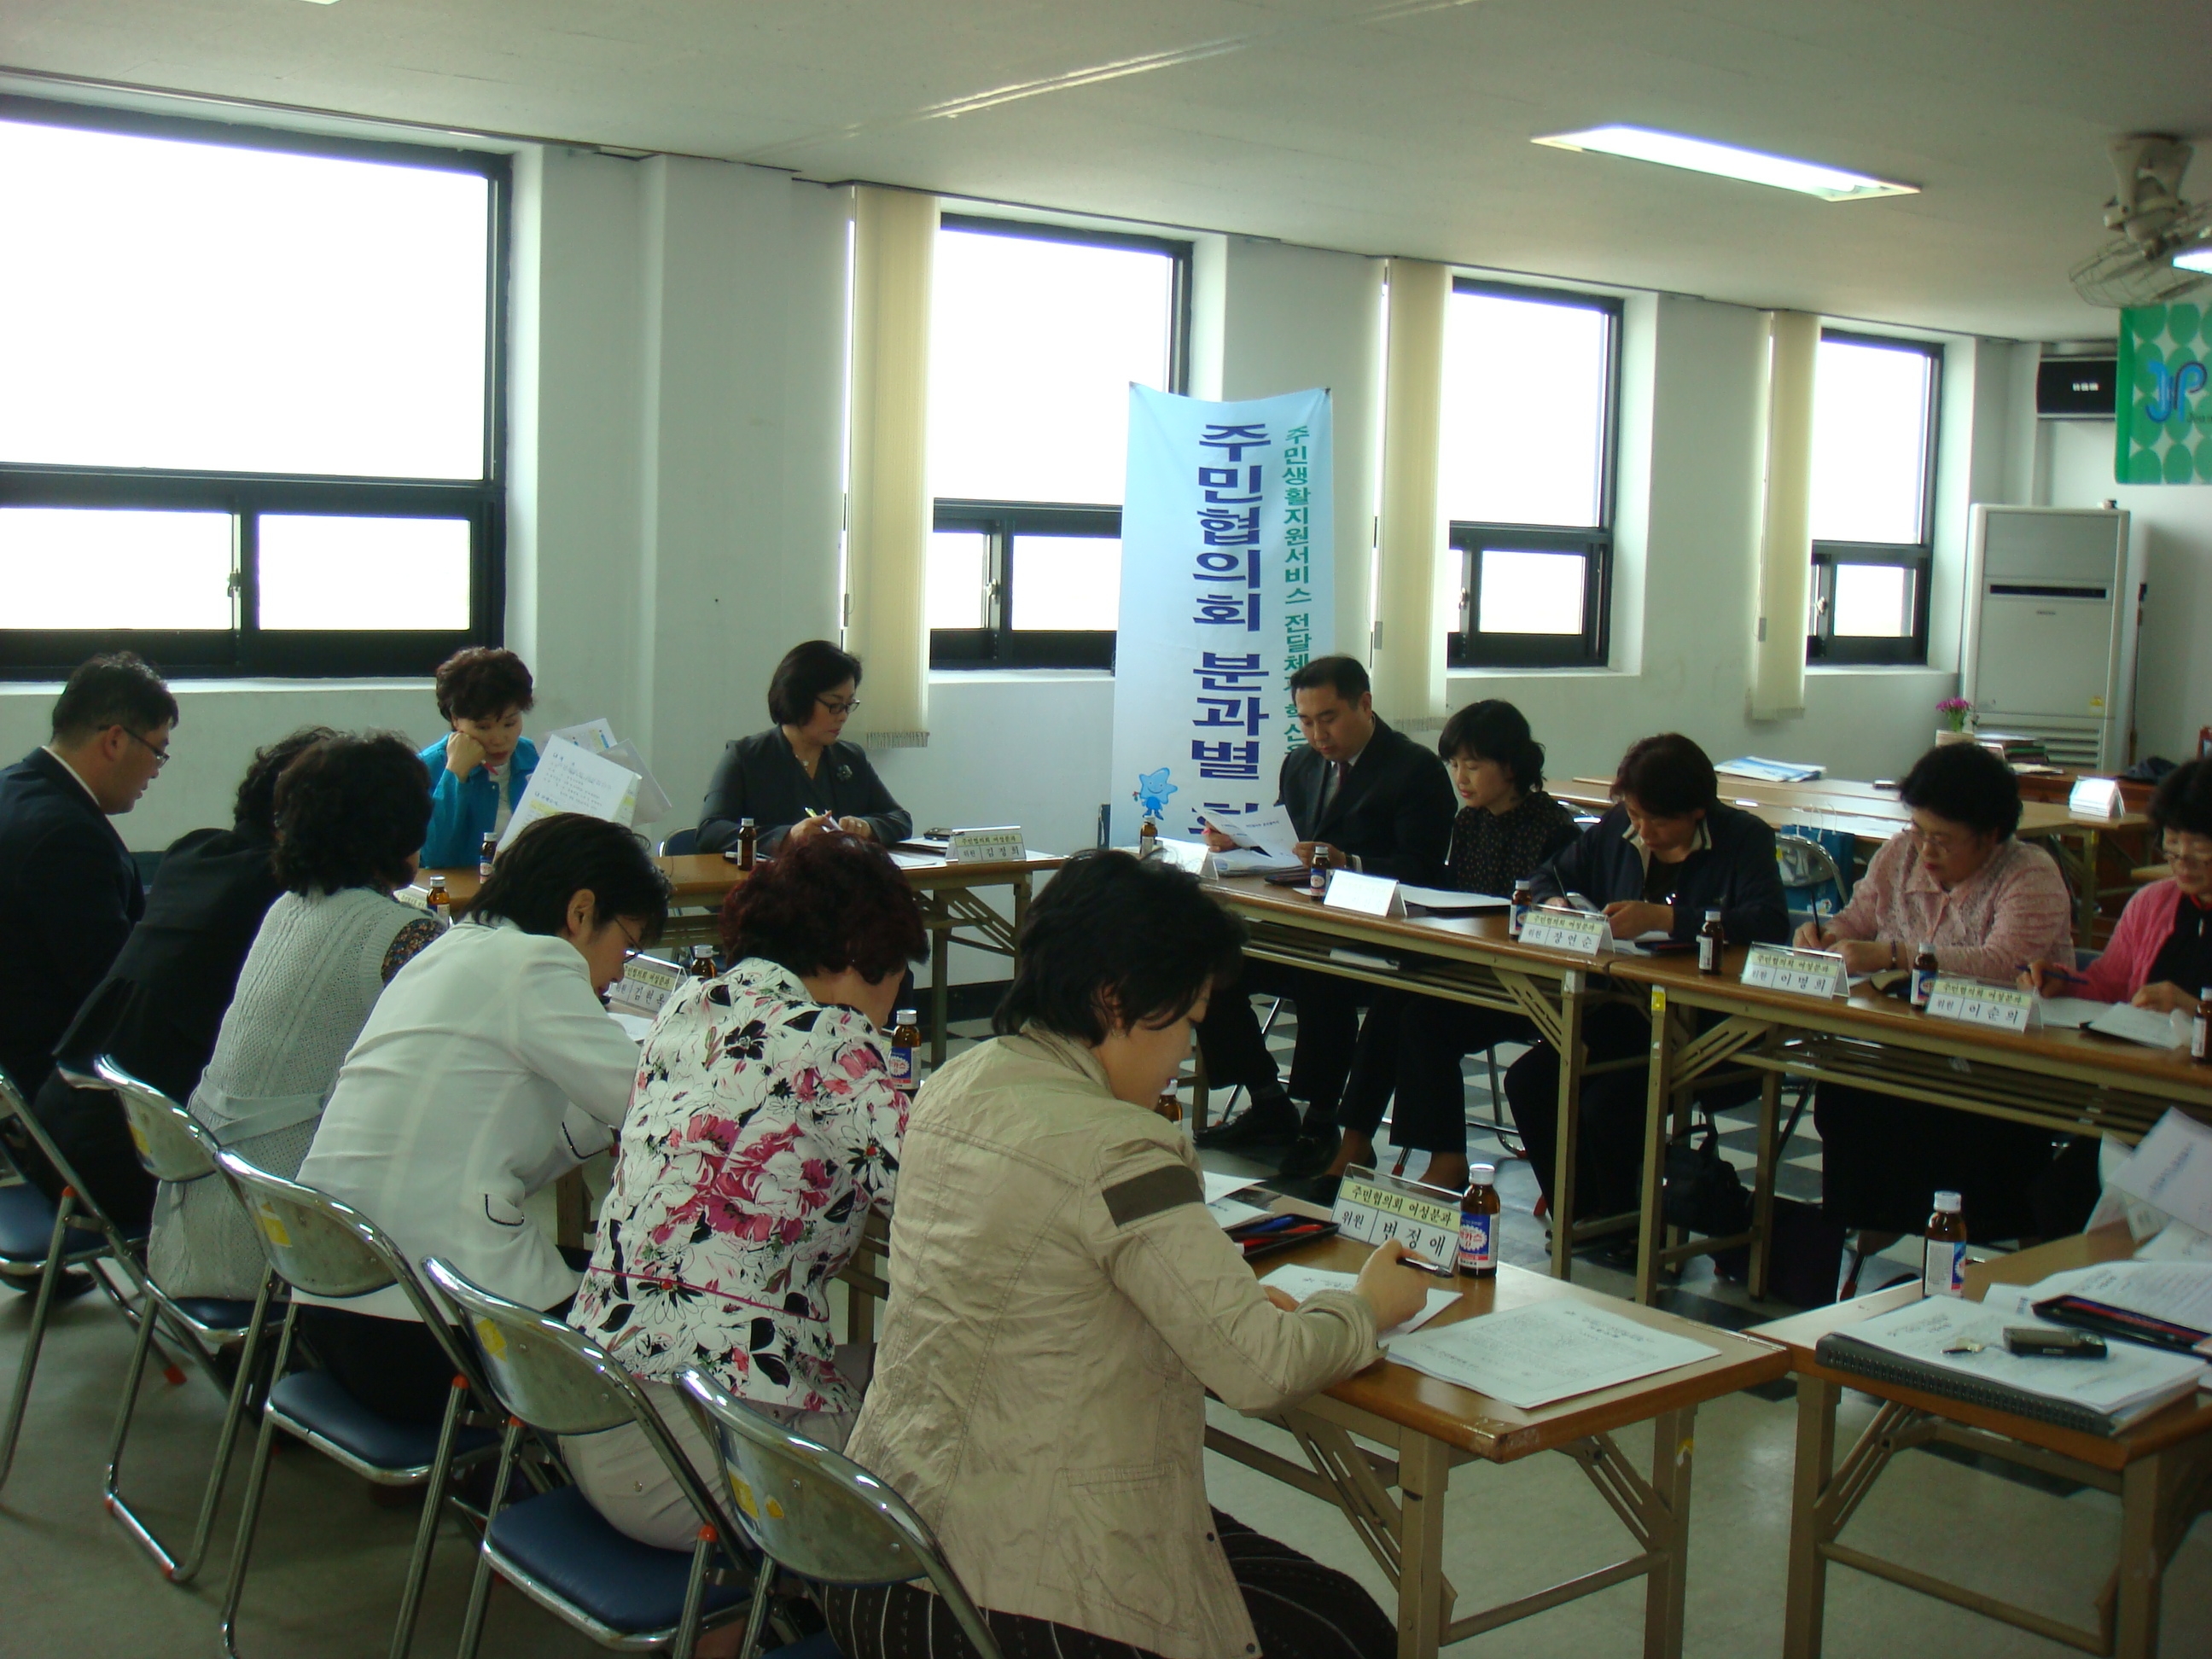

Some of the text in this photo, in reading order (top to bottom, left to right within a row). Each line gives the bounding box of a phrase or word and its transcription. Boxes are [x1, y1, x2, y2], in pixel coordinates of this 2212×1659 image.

[1192, 424, 1271, 632] 주민협의회
[1283, 425, 1312, 605] 주민생활지원서비스
[1284, 613, 1312, 691] 전달체
[1191, 651, 1270, 780] 분과별
[1342, 1211, 1364, 1230] 위원
[1352, 1185, 1403, 1212] 주민협의회
